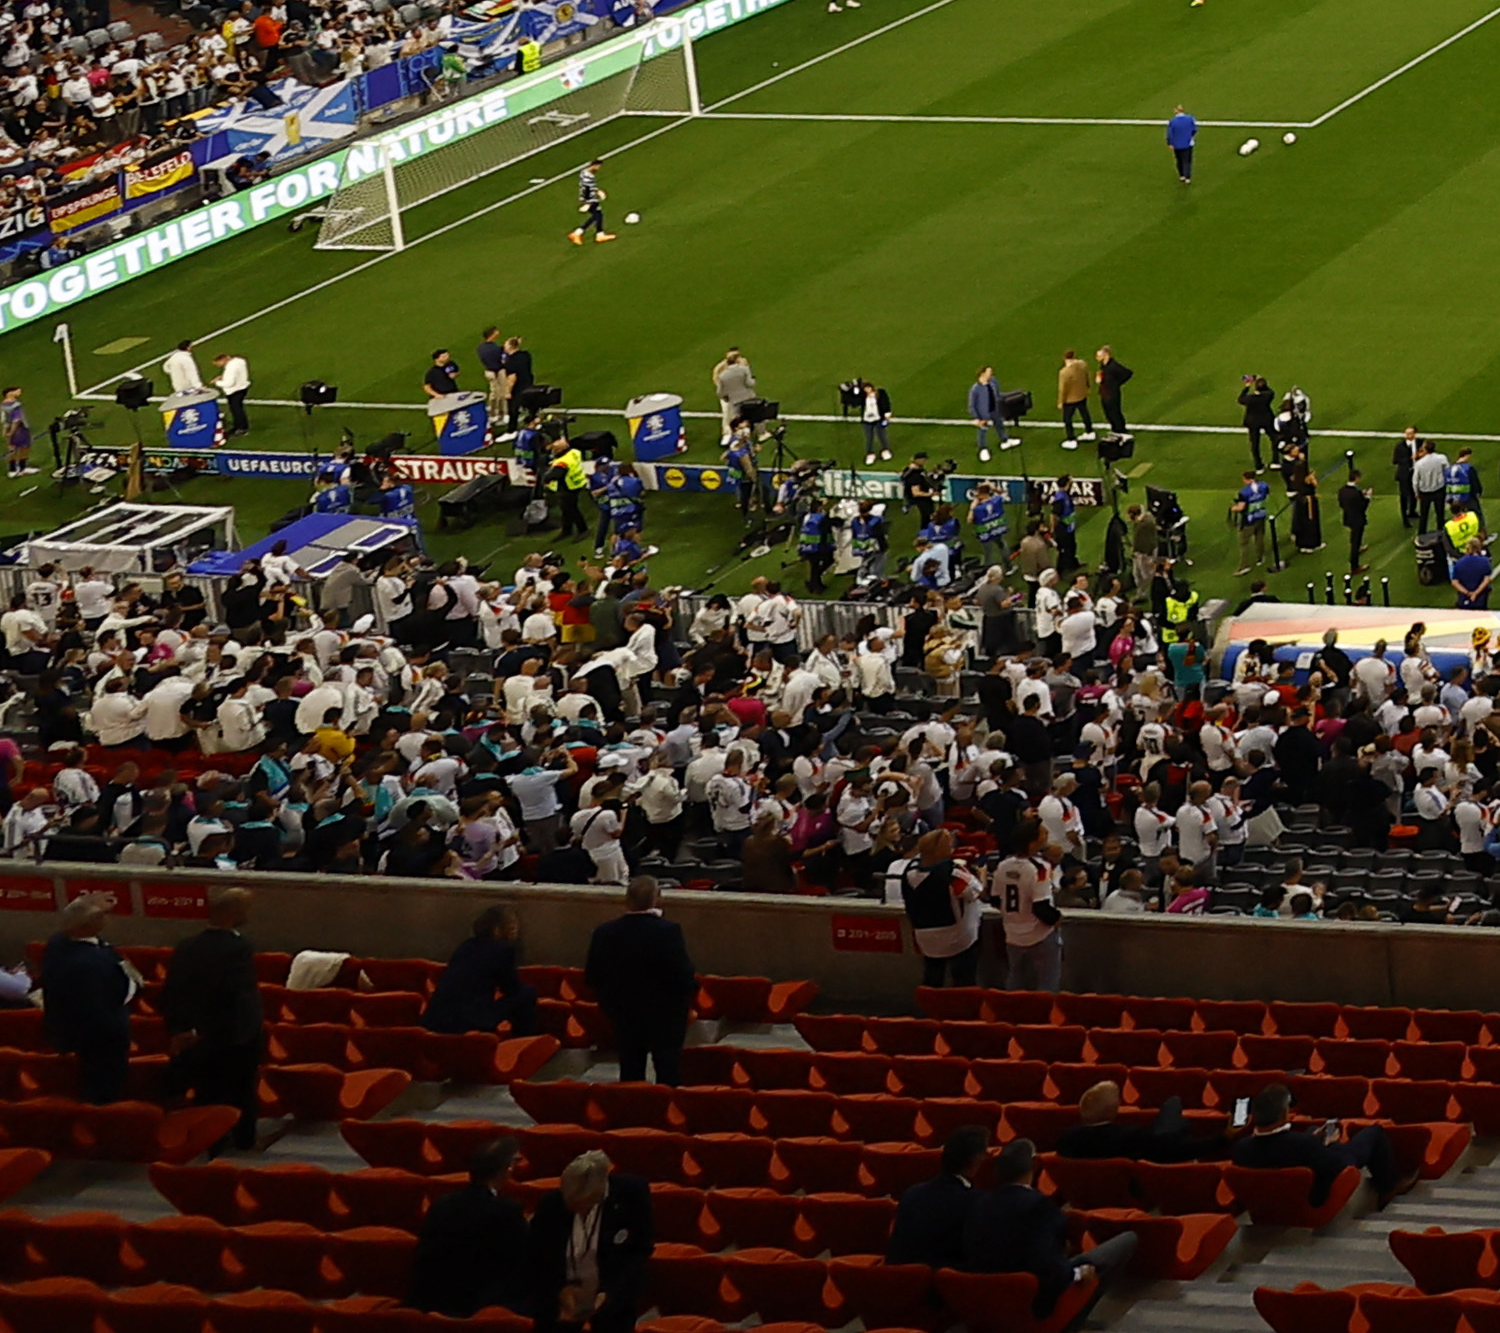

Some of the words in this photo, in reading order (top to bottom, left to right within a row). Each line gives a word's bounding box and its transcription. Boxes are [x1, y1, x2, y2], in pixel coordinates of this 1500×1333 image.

[124, 149, 193, 187] BIELEFELD
[0, 201, 245, 326] TOGETHER
[249, 160, 339, 222] FOR
[346, 89, 508, 182] NATURE
[0, 205, 45, 240] ZIG
[394, 458, 506, 482] STRAUSS
